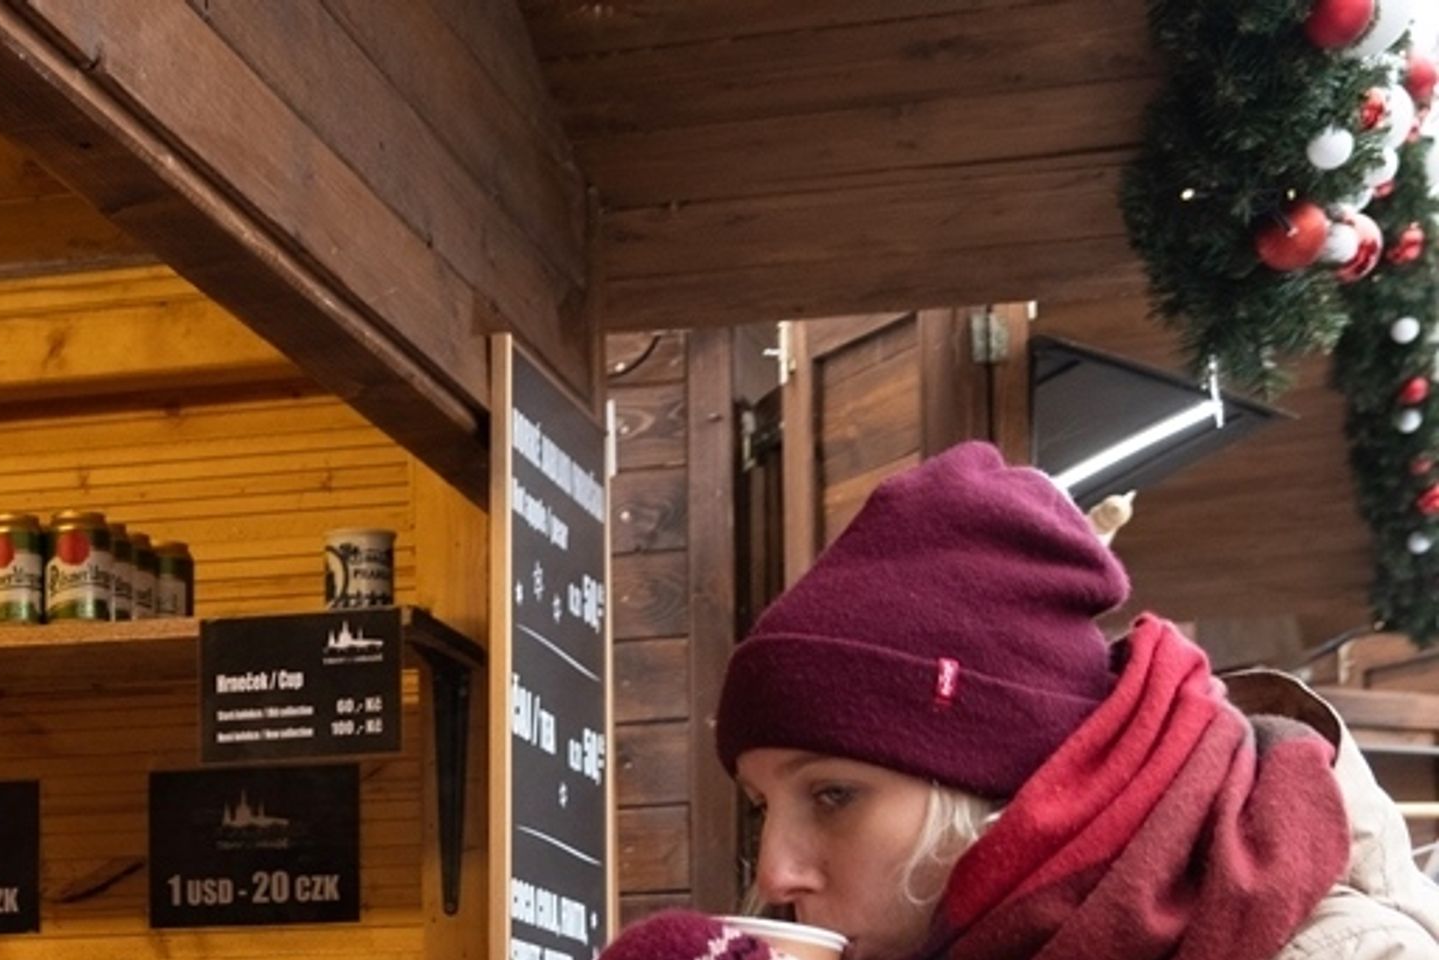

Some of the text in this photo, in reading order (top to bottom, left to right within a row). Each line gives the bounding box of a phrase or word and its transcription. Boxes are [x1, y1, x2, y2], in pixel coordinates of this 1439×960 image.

[167, 874, 181, 906] 1
[187, 878, 233, 906] USD
[252, 870, 289, 903] 20
[295, 874, 340, 902] CZK
